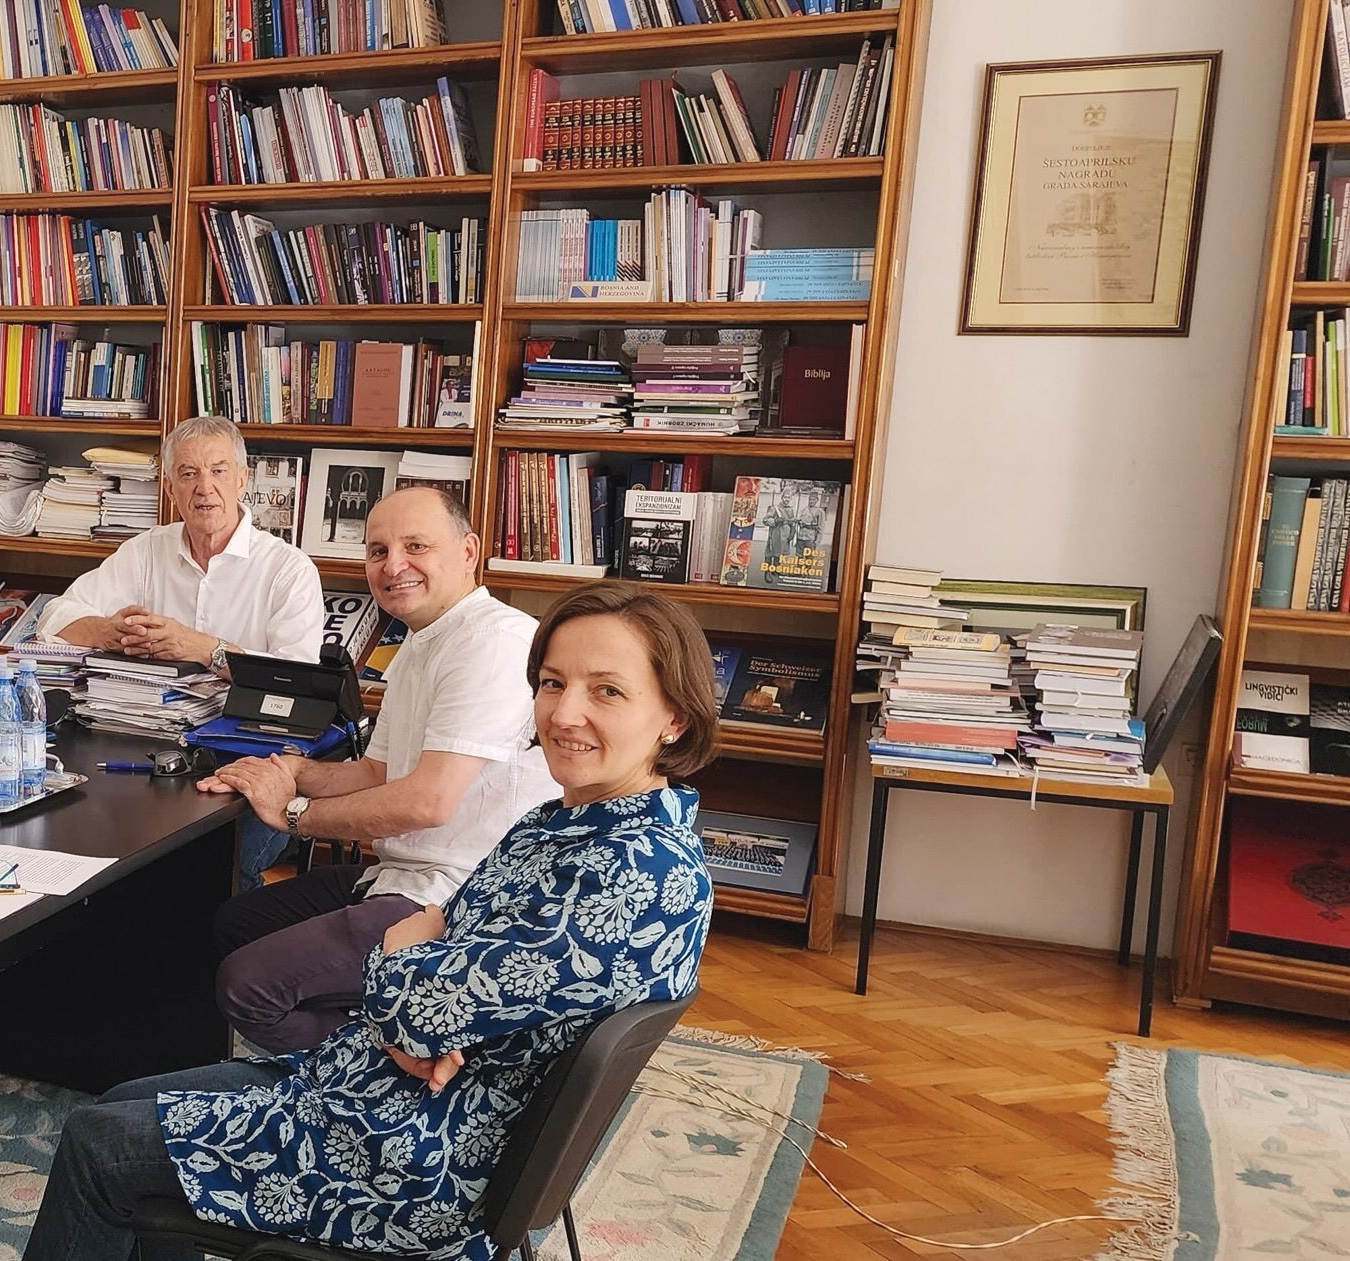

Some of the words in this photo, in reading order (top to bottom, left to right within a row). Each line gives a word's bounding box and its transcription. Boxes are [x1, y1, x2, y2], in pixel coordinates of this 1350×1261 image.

[1043, 182, 1077, 190] GRADA
[1079, 181, 1129, 189] SARAJEVA
[804, 369, 831, 381] Biblija
[237, 491, 287, 507] AJEVO
[803, 547, 826, 557] Des
[779, 554, 825, 567] Kaisers
[760, 562, 823, 577] Bosniaken
[323, 614, 349, 631] E
[749, 665, 821, 678] Symbolismus
[770, 661, 823, 674] Schweizer
[1259, 691, 1284, 701] VIDICI
